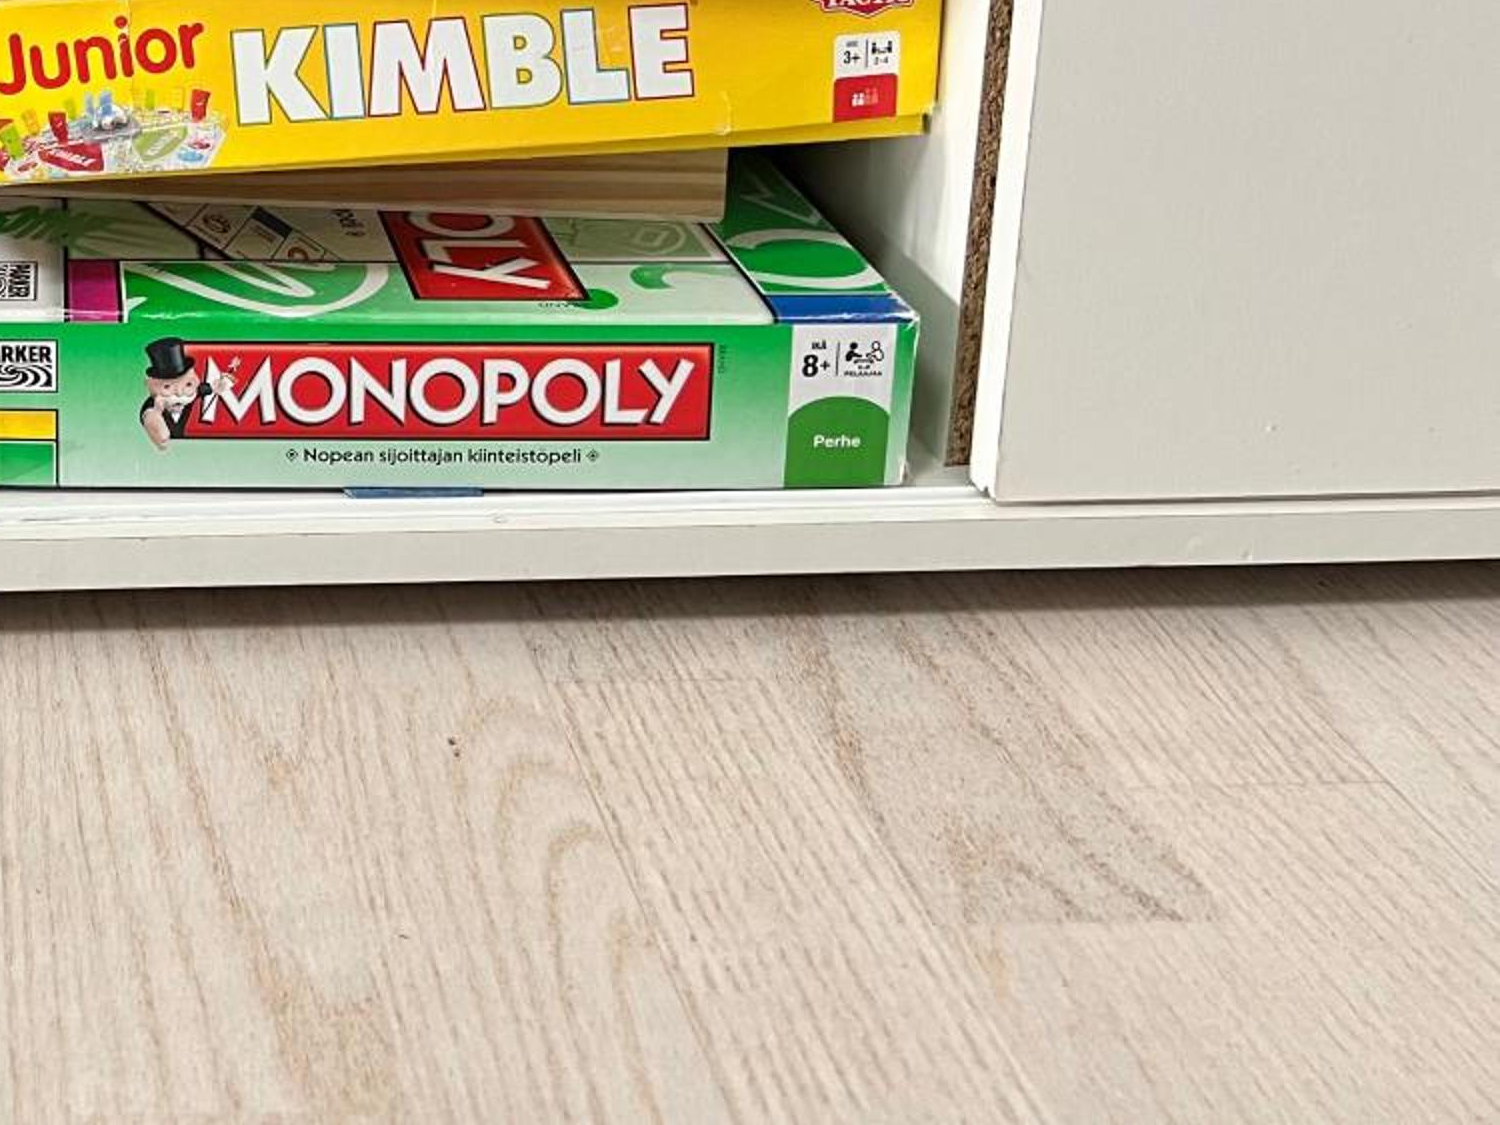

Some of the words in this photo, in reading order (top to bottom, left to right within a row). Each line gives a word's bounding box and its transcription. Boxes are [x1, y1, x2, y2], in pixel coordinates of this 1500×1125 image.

[229, 2, 696, 129] KIMBLE
[802, 354, 831, 377] 8+
[201, 356, 696, 426] MONOPOLY
[813, 434, 861, 448] Perhe
[303, 448, 374, 464] Nopean
[378, 448, 463, 465] sijoittajan
